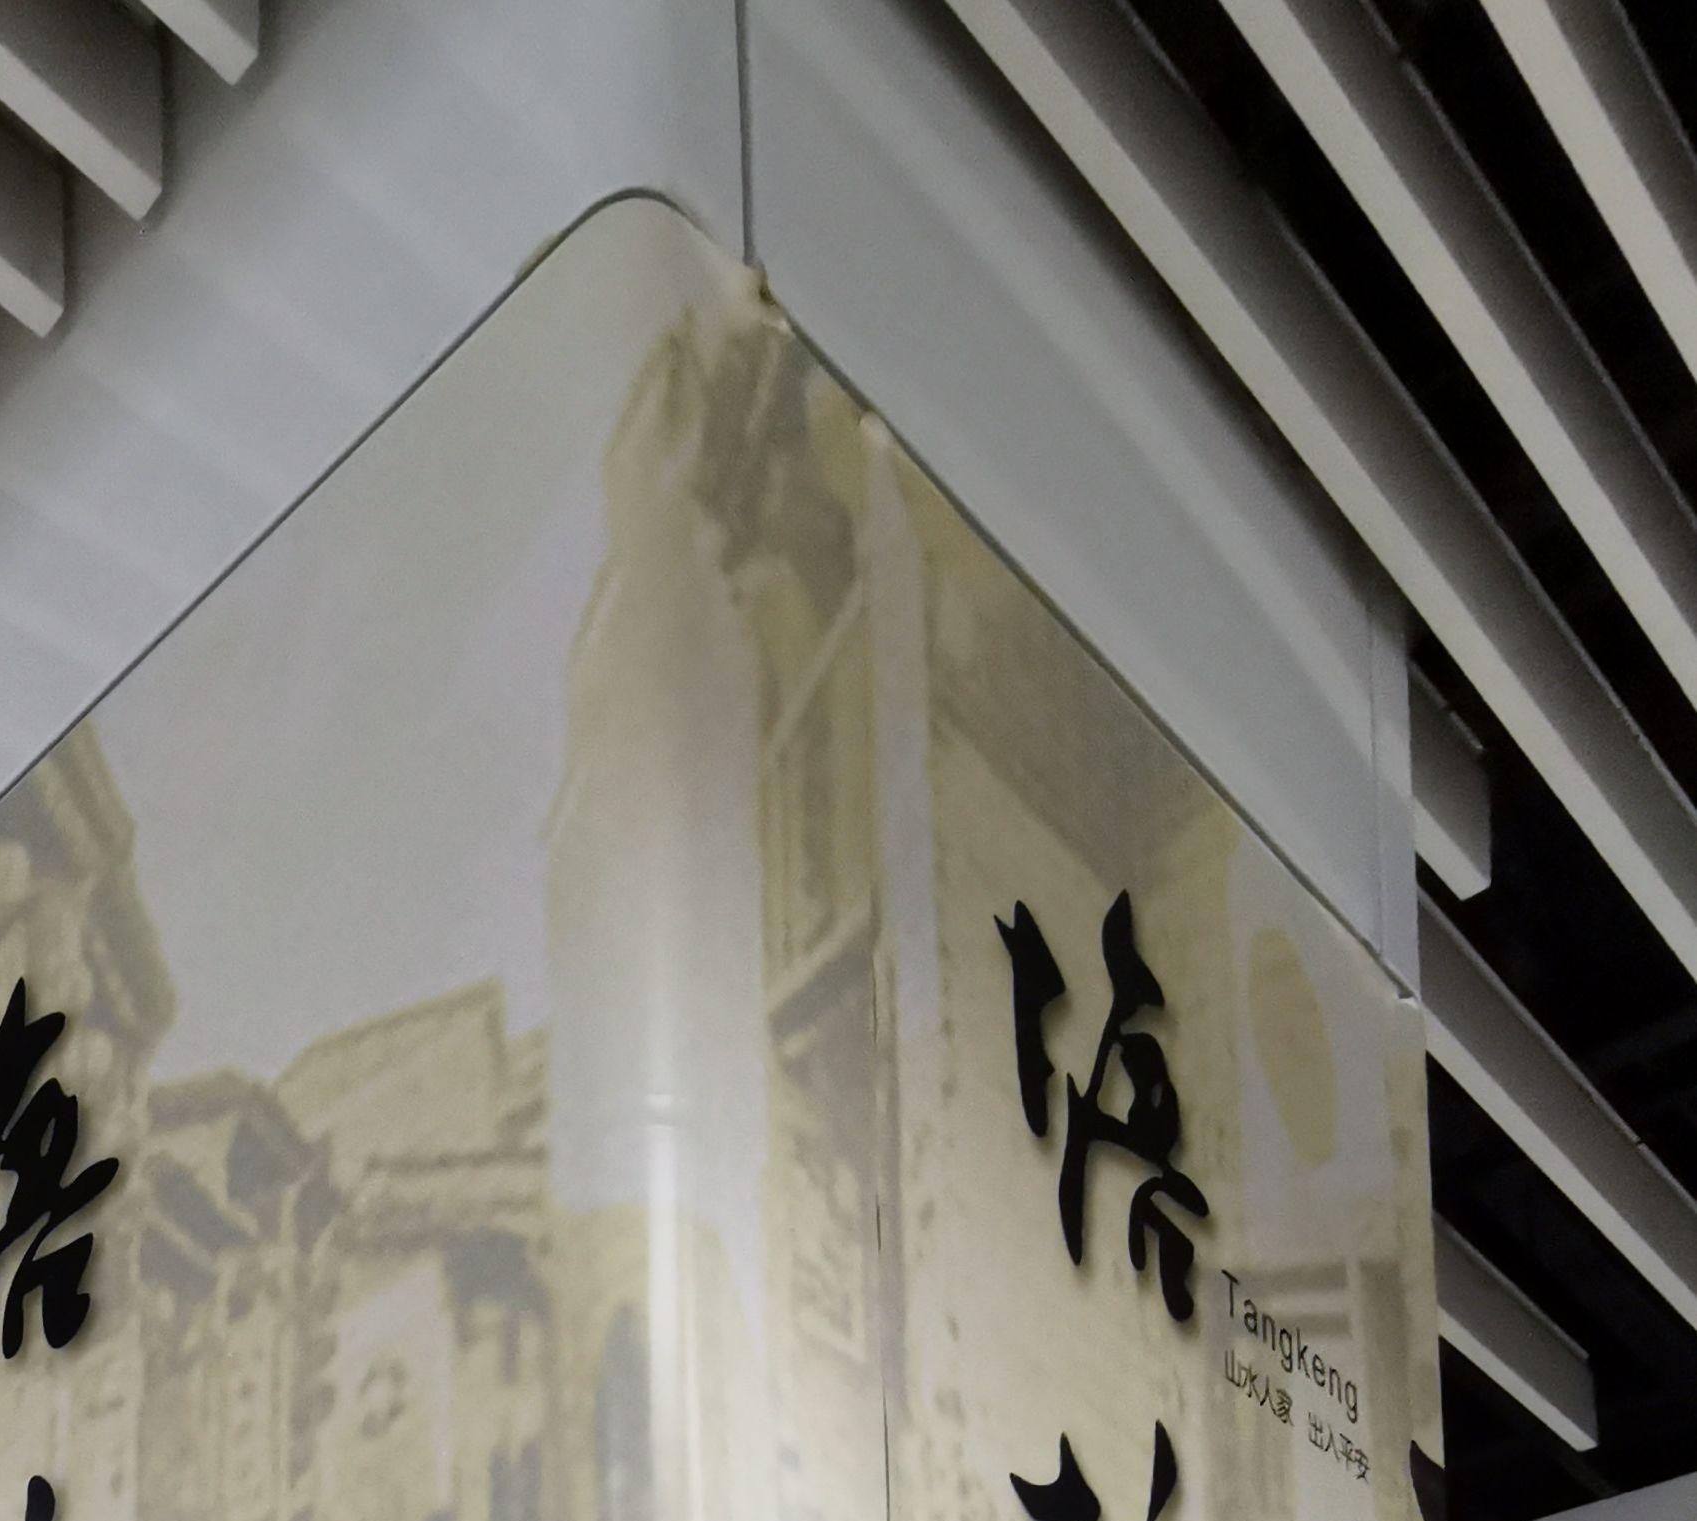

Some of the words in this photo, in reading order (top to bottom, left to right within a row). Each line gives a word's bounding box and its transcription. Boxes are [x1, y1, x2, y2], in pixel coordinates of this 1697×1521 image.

[1221, 1268, 1359, 1424] Tangkeng
[1224, 1350, 1294, 1427] 山水人家
[1308, 1411, 1370, 1485] 出入平安
